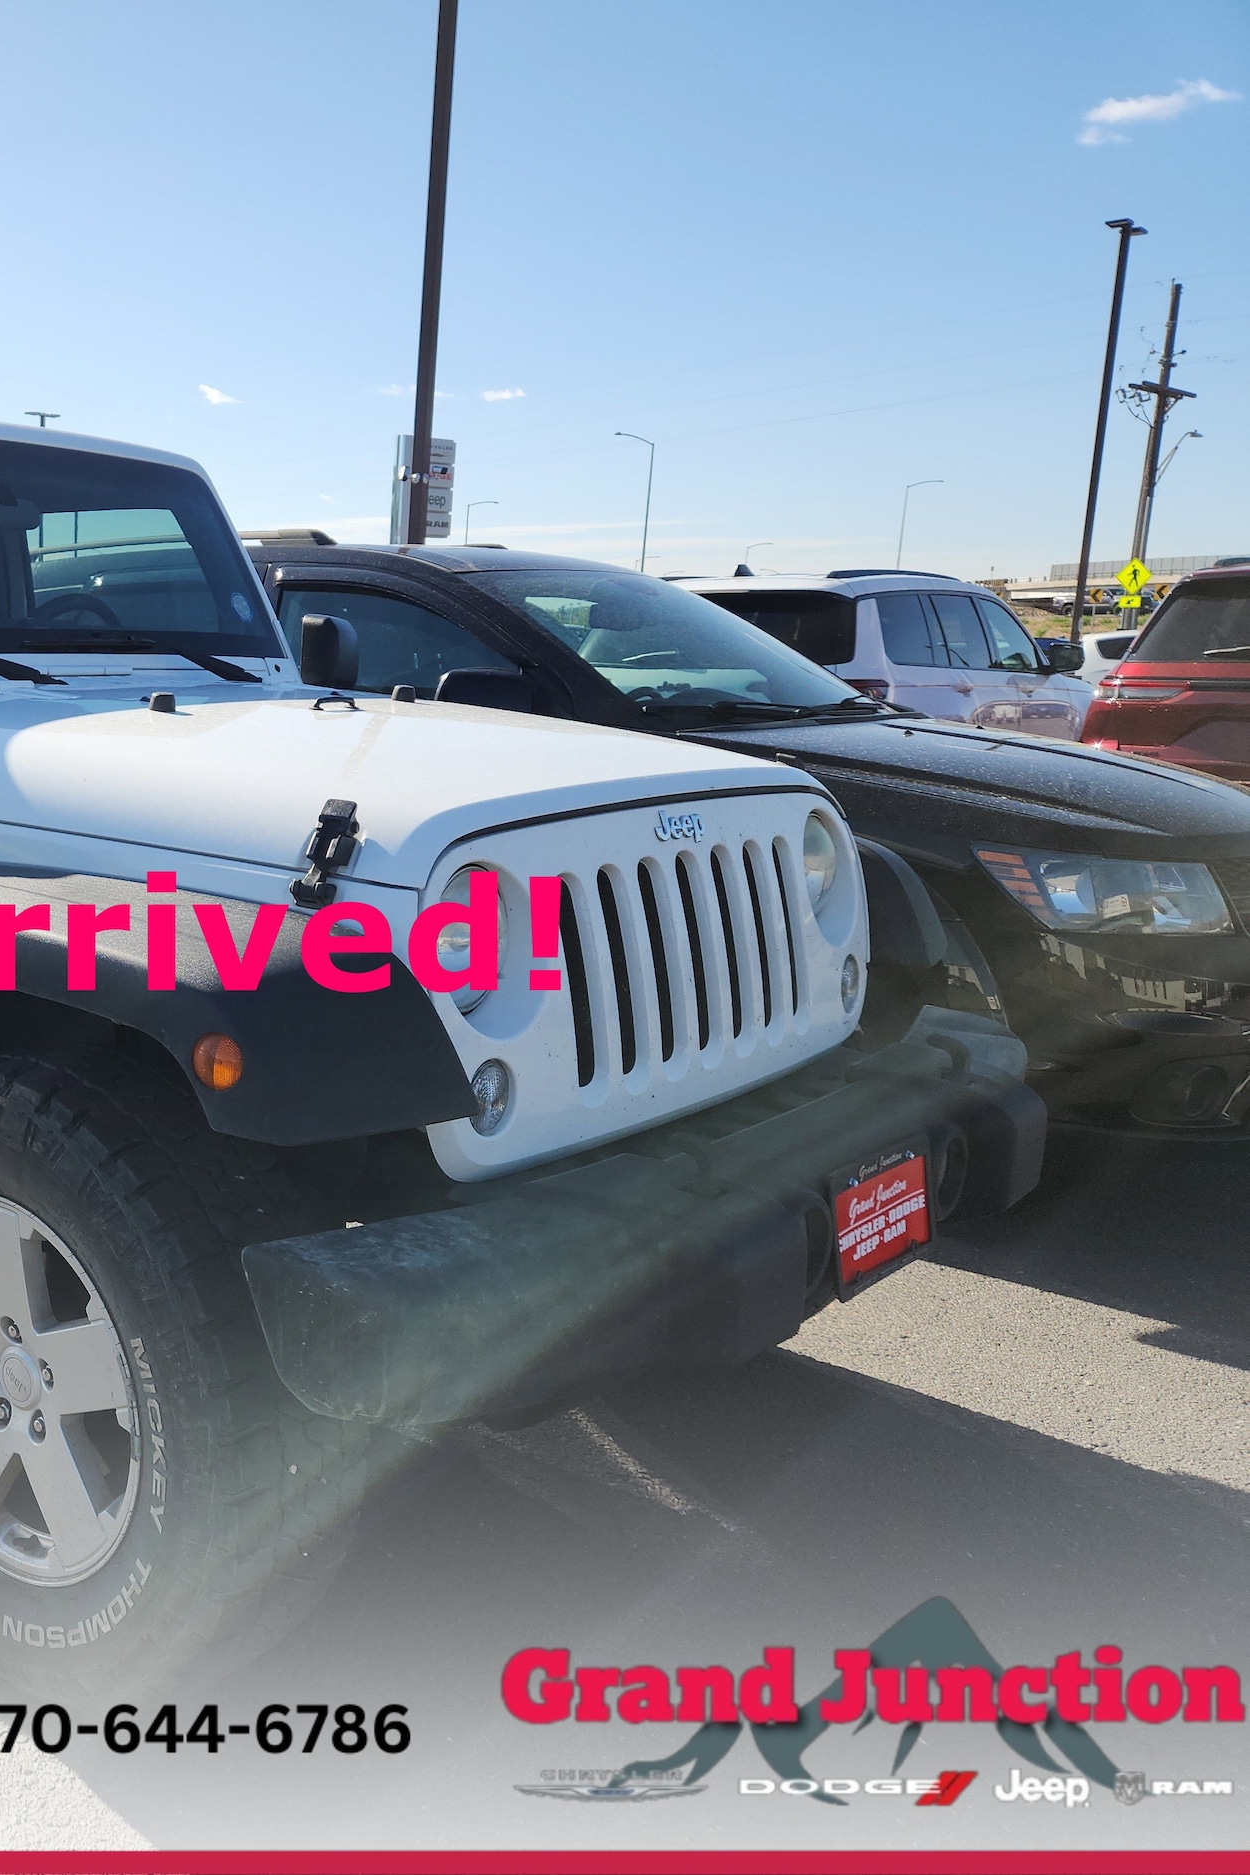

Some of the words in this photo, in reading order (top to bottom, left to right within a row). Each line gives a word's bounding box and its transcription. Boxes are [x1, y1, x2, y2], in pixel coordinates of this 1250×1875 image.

[429, 495, 447, 508] eep
[426, 520, 449, 529] RAM
[654, 810, 705, 843] Jeep
[848, 1189, 876, 1226] Grand
[875, 1179, 907, 1211] Junction
[853, 1234, 880, 1261] JEEP
[883, 1219, 907, 1243] RAM
[130, 1337, 167, 1535] MICKEY
[2, 1558, 152, 1648] THOMPSON
